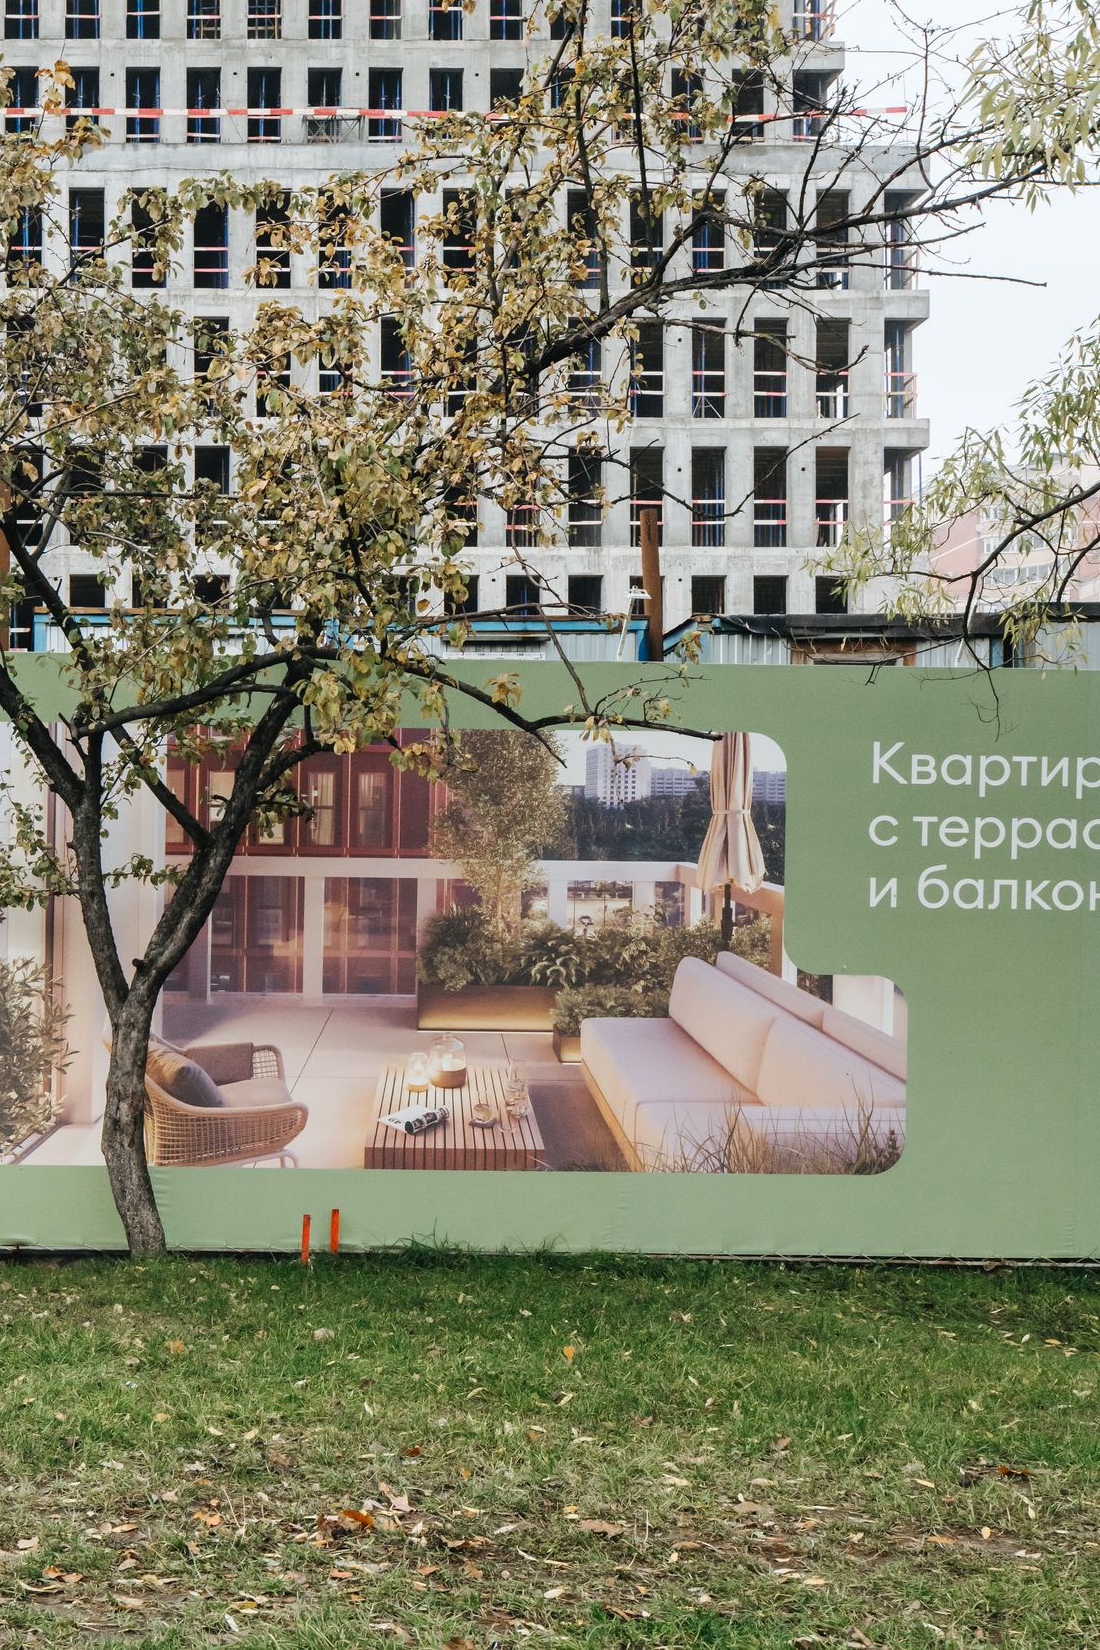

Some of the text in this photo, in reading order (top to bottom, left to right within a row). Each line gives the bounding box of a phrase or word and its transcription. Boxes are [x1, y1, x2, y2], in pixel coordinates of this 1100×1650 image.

[872, 741, 1100, 799] Квартир
[868, 815, 899, 847] с
[869, 877, 898, 908] и
